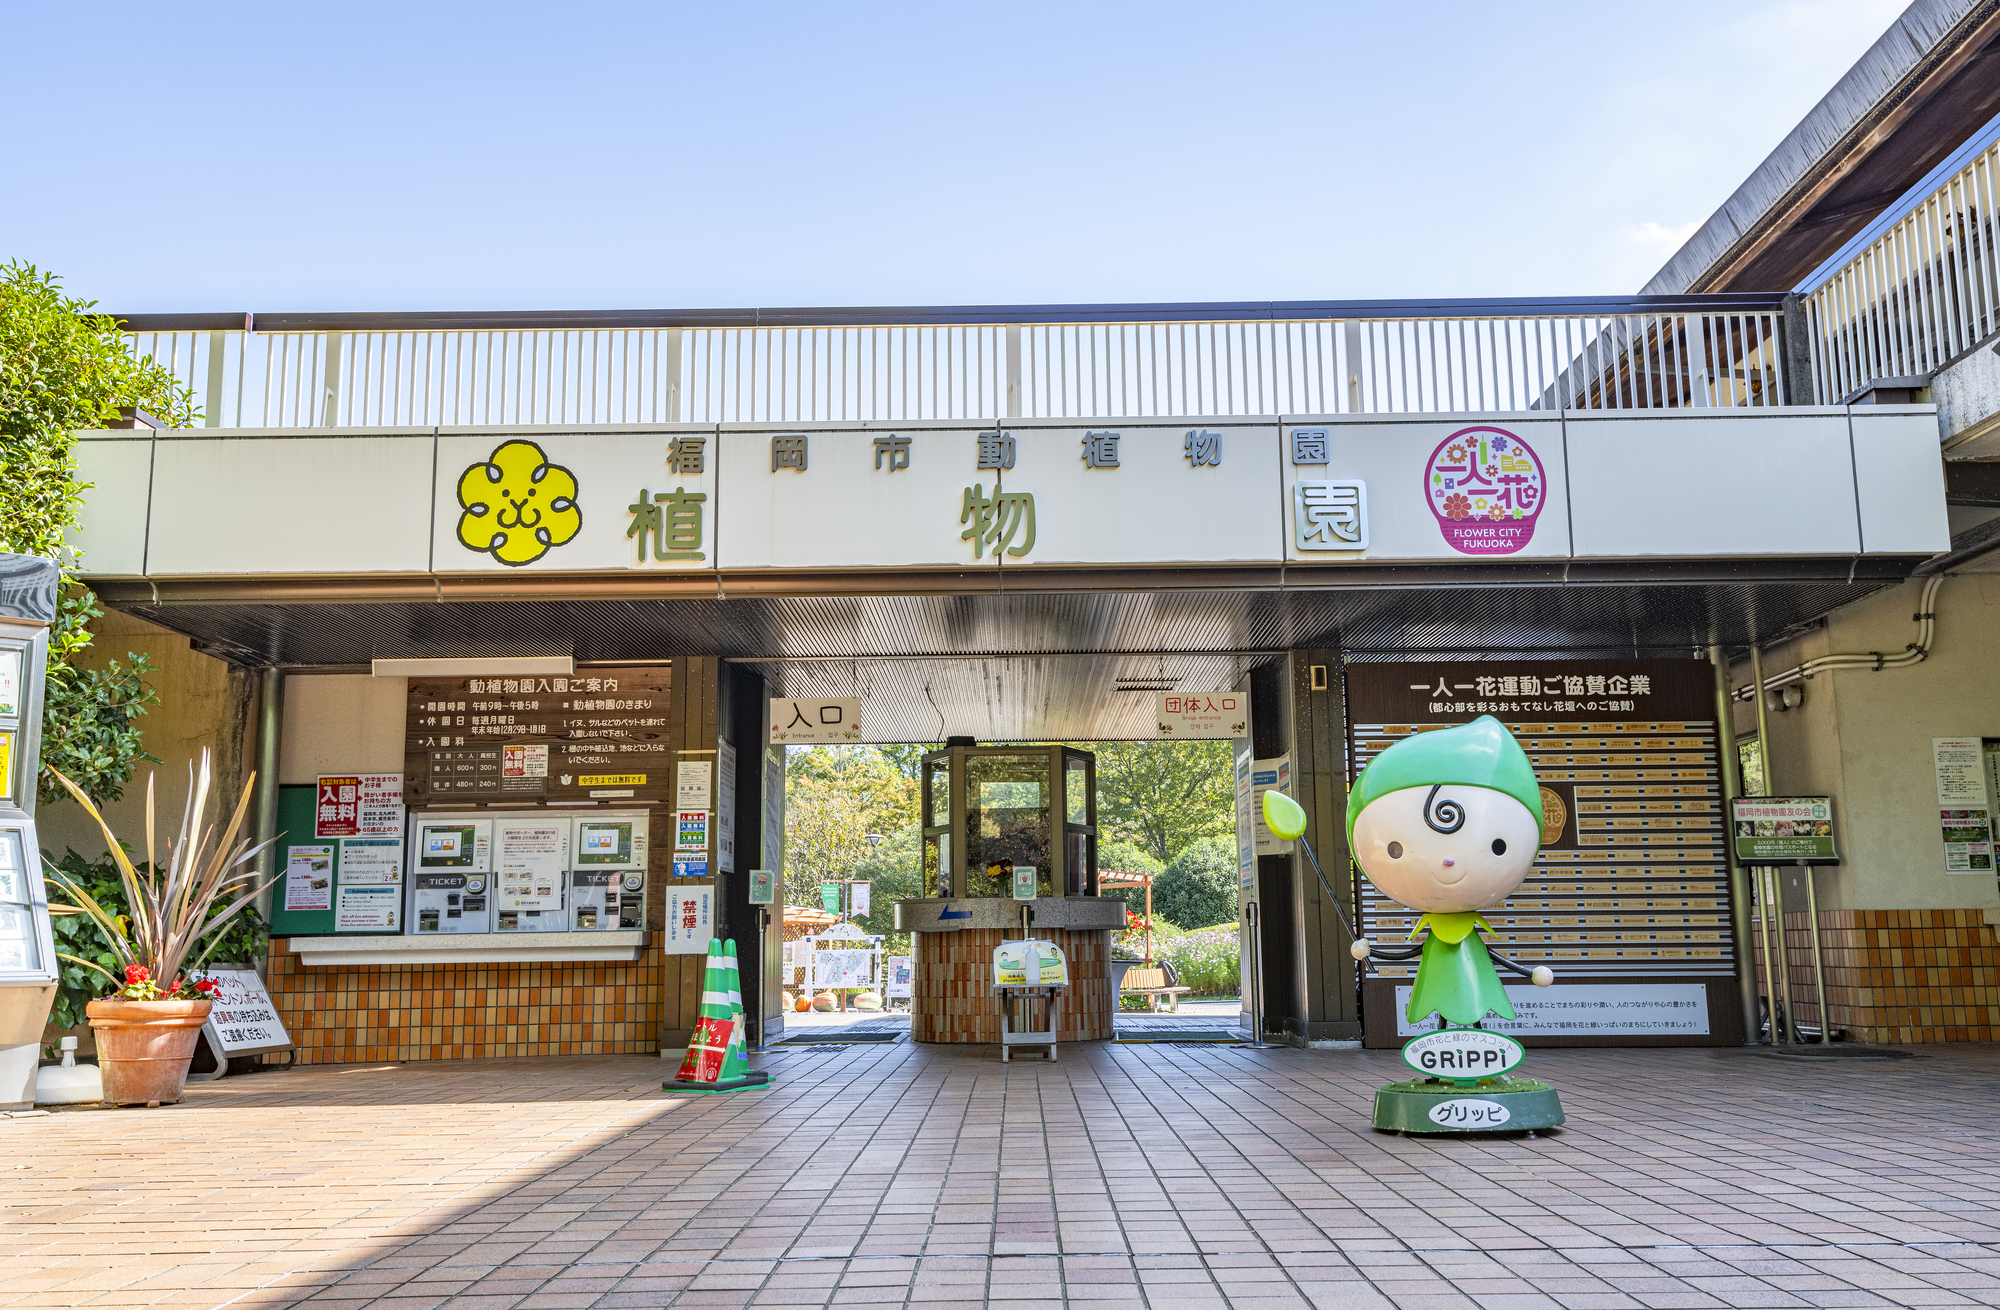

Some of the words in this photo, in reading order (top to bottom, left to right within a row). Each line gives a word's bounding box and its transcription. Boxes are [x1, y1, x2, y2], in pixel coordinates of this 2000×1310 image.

[667, 428, 1330, 474] 福岡市動植物園
[627, 479, 1370, 563] 植物園
[1454, 529, 1496, 538] FLOWER
[1498, 528, 1522, 537] CITY
[1464, 540, 1514, 548] FUKUOKA
[470, 678, 618, 694] 動植物園入園ご案内
[1410, 675, 1650, 697] 一人一花運動ご協賛企業
[427, 702, 466, 712] 開園時間
[573, 700, 652, 710] 動植物園のきまり
[1166, 697, 1236, 714] 団体入口
[1428, 700, 1634, 714] (都心部を彩るおもてなし花壇へのご協賛)
[427, 716, 464, 726] 休園日
[472, 716, 514, 725] 毎週月曜日
[787, 702, 842, 728] 入口
[426, 736, 464, 746] 入園料
[582, 776, 642, 784] 中学生までは無料です
[320, 786, 356, 803] 入園
[319, 804, 356, 821] 無料
[1738, 807, 1811, 817] 福岡市植物園友の会
[683, 900, 697, 928] 禁煙
[1410, 1033, 1514, 1054] 福岡市花と緑のマスコット
[1437, 1104, 1502, 1122] グリッピ
